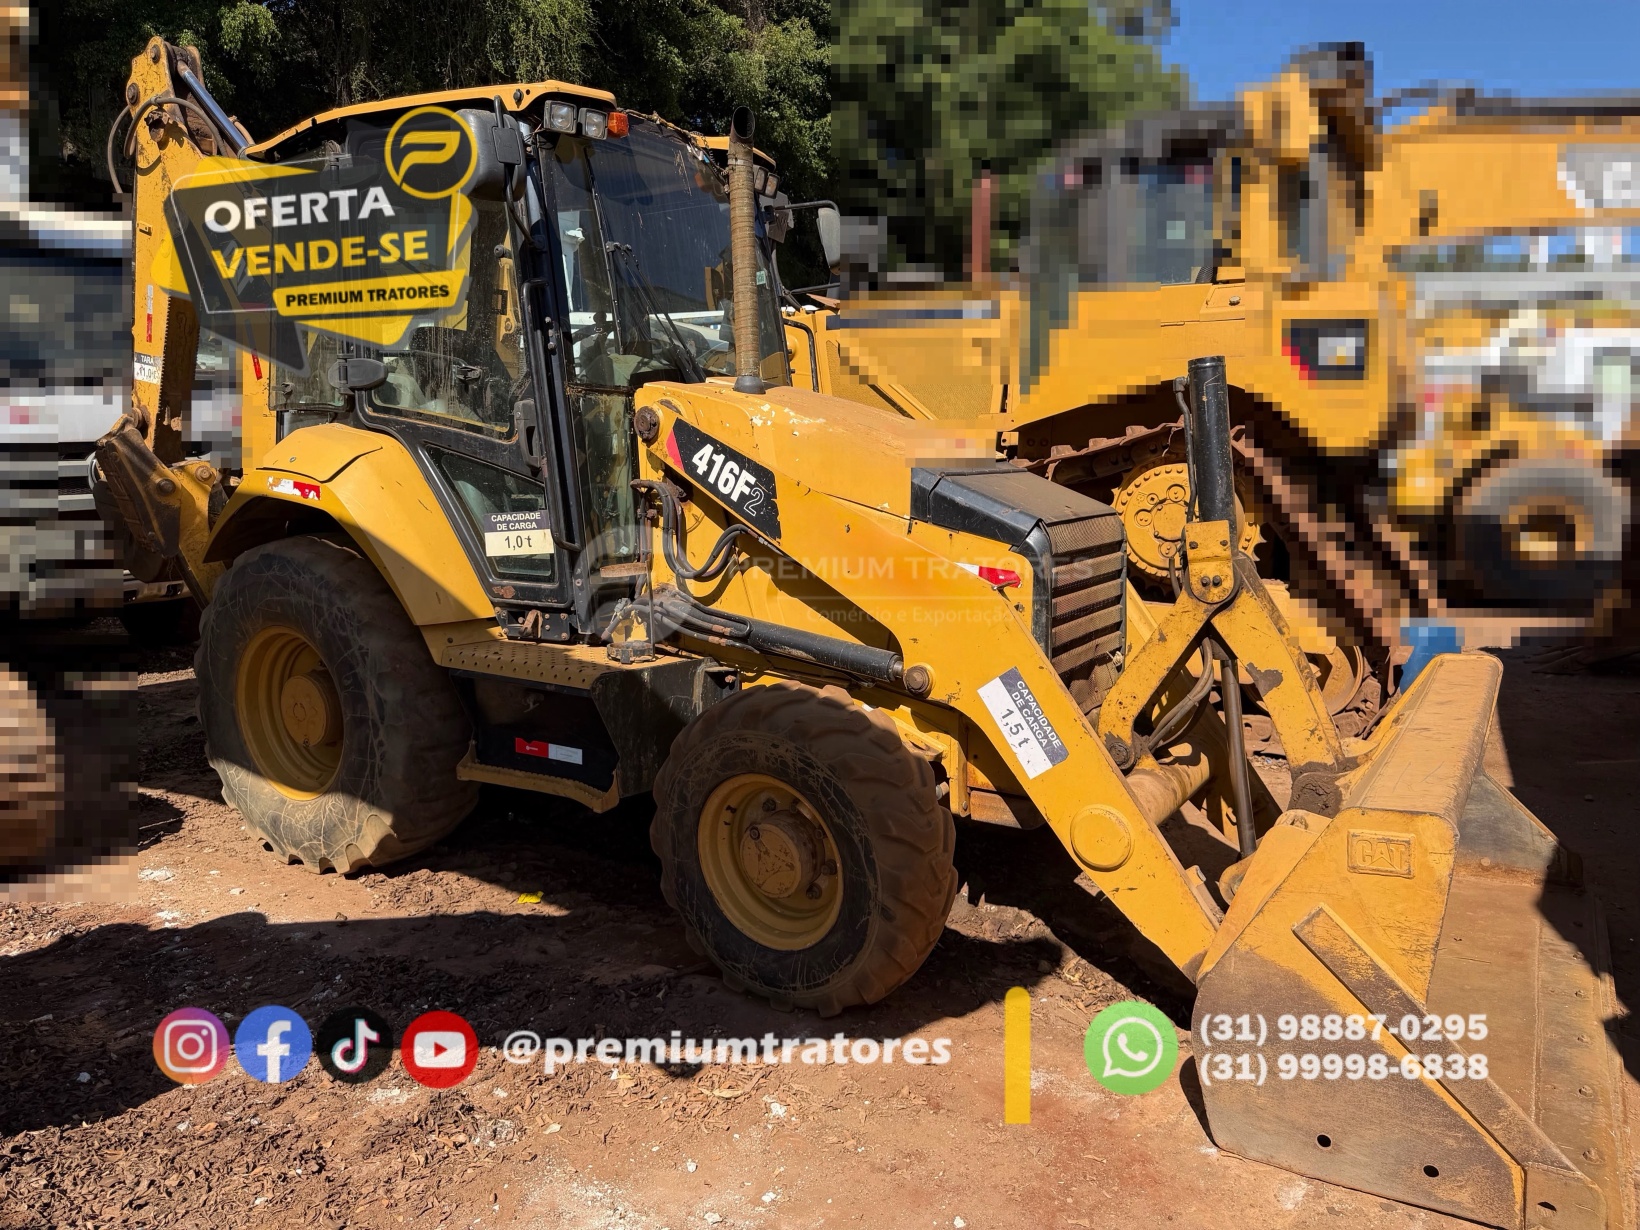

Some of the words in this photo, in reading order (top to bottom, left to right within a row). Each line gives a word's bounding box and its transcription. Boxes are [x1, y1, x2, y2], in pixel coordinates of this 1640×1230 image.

[141, 355, 153, 365] TARA
[691, 443, 765, 517] 416F2
[491, 512, 541, 522] CAPACIDADE
[496, 523, 508, 531] DE
[509, 521, 537, 530] CARGA
[504, 535, 523, 551] 1,0
[525, 536, 532, 548] t
[1002, 708, 1024, 736] 1,5
[1018, 737, 1030, 748] t
[1012, 692, 1025, 708] DE
[1023, 709, 1048, 747] CARGA
[1017, 680, 1061, 748] CAPACIDADE
[1356, 840, 1405, 871] CAT
